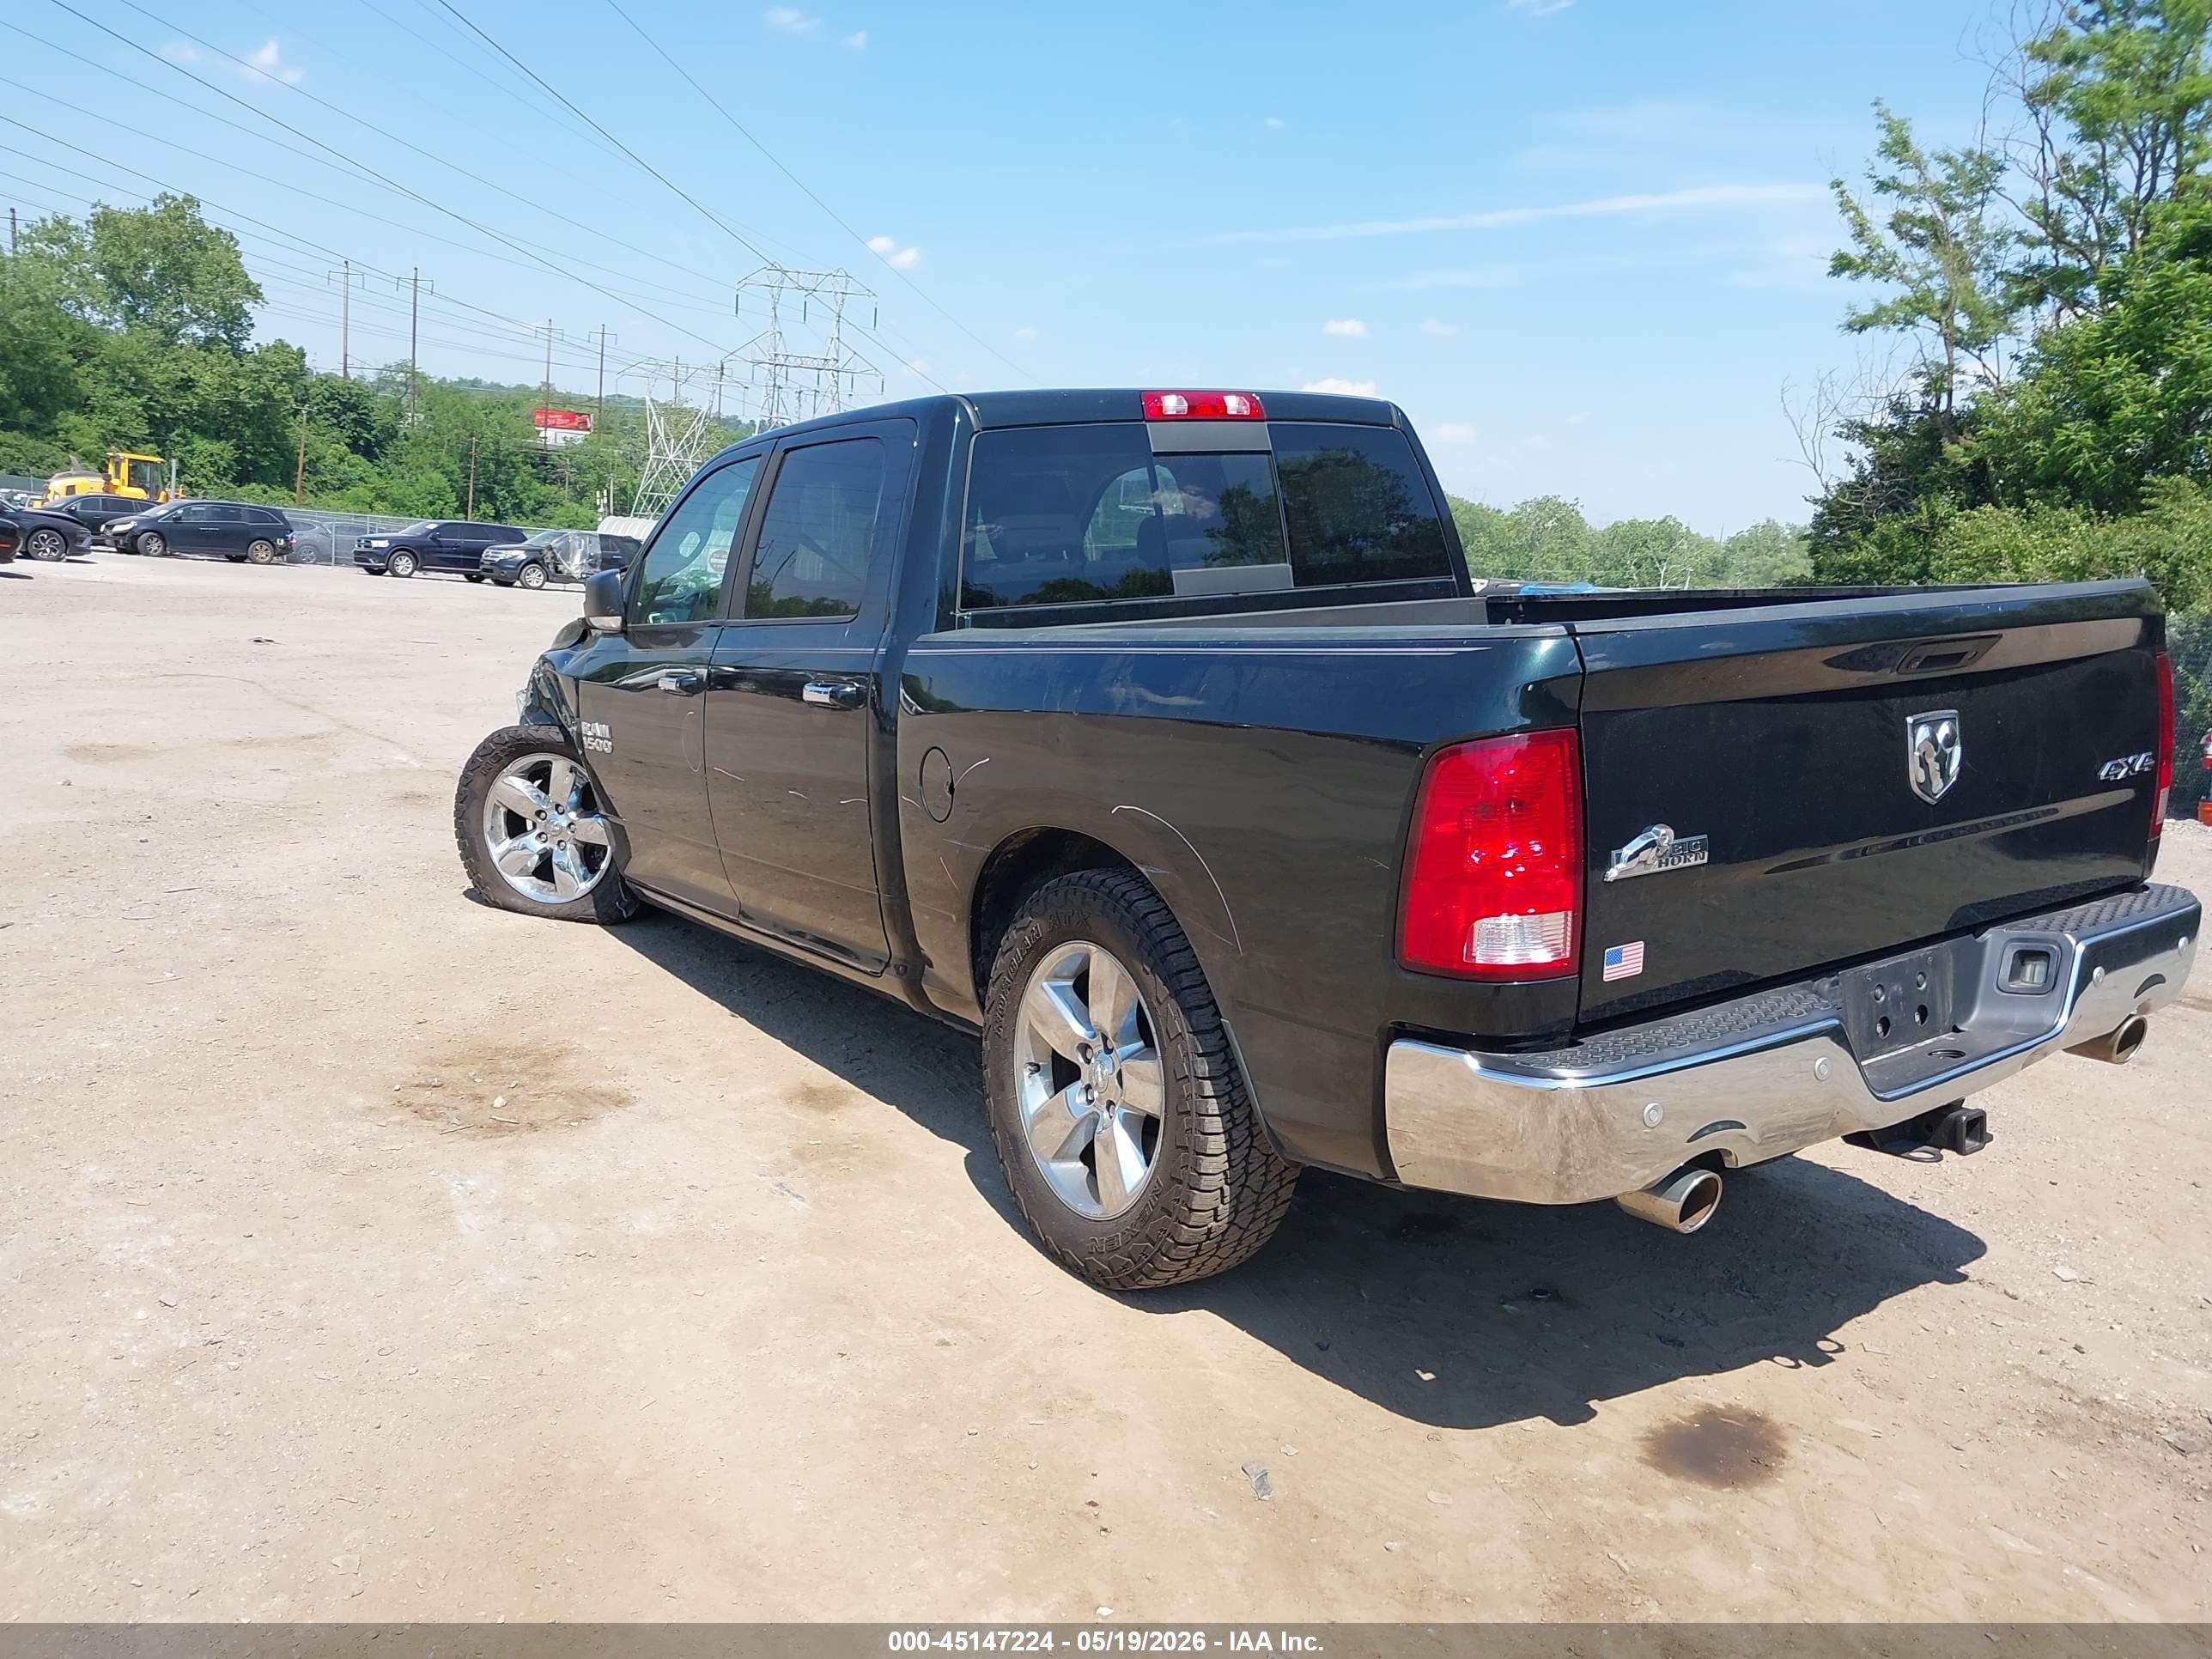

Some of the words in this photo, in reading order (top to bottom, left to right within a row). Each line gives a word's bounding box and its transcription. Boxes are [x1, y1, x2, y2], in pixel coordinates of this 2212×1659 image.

[582, 736, 613, 754] 1500
[1671, 841, 1702, 855] BIG
[1658, 851, 1705, 868] HORN
[1048, 909, 1092, 929] ATX
[1088, 1176, 1164, 1244] NEXEN
